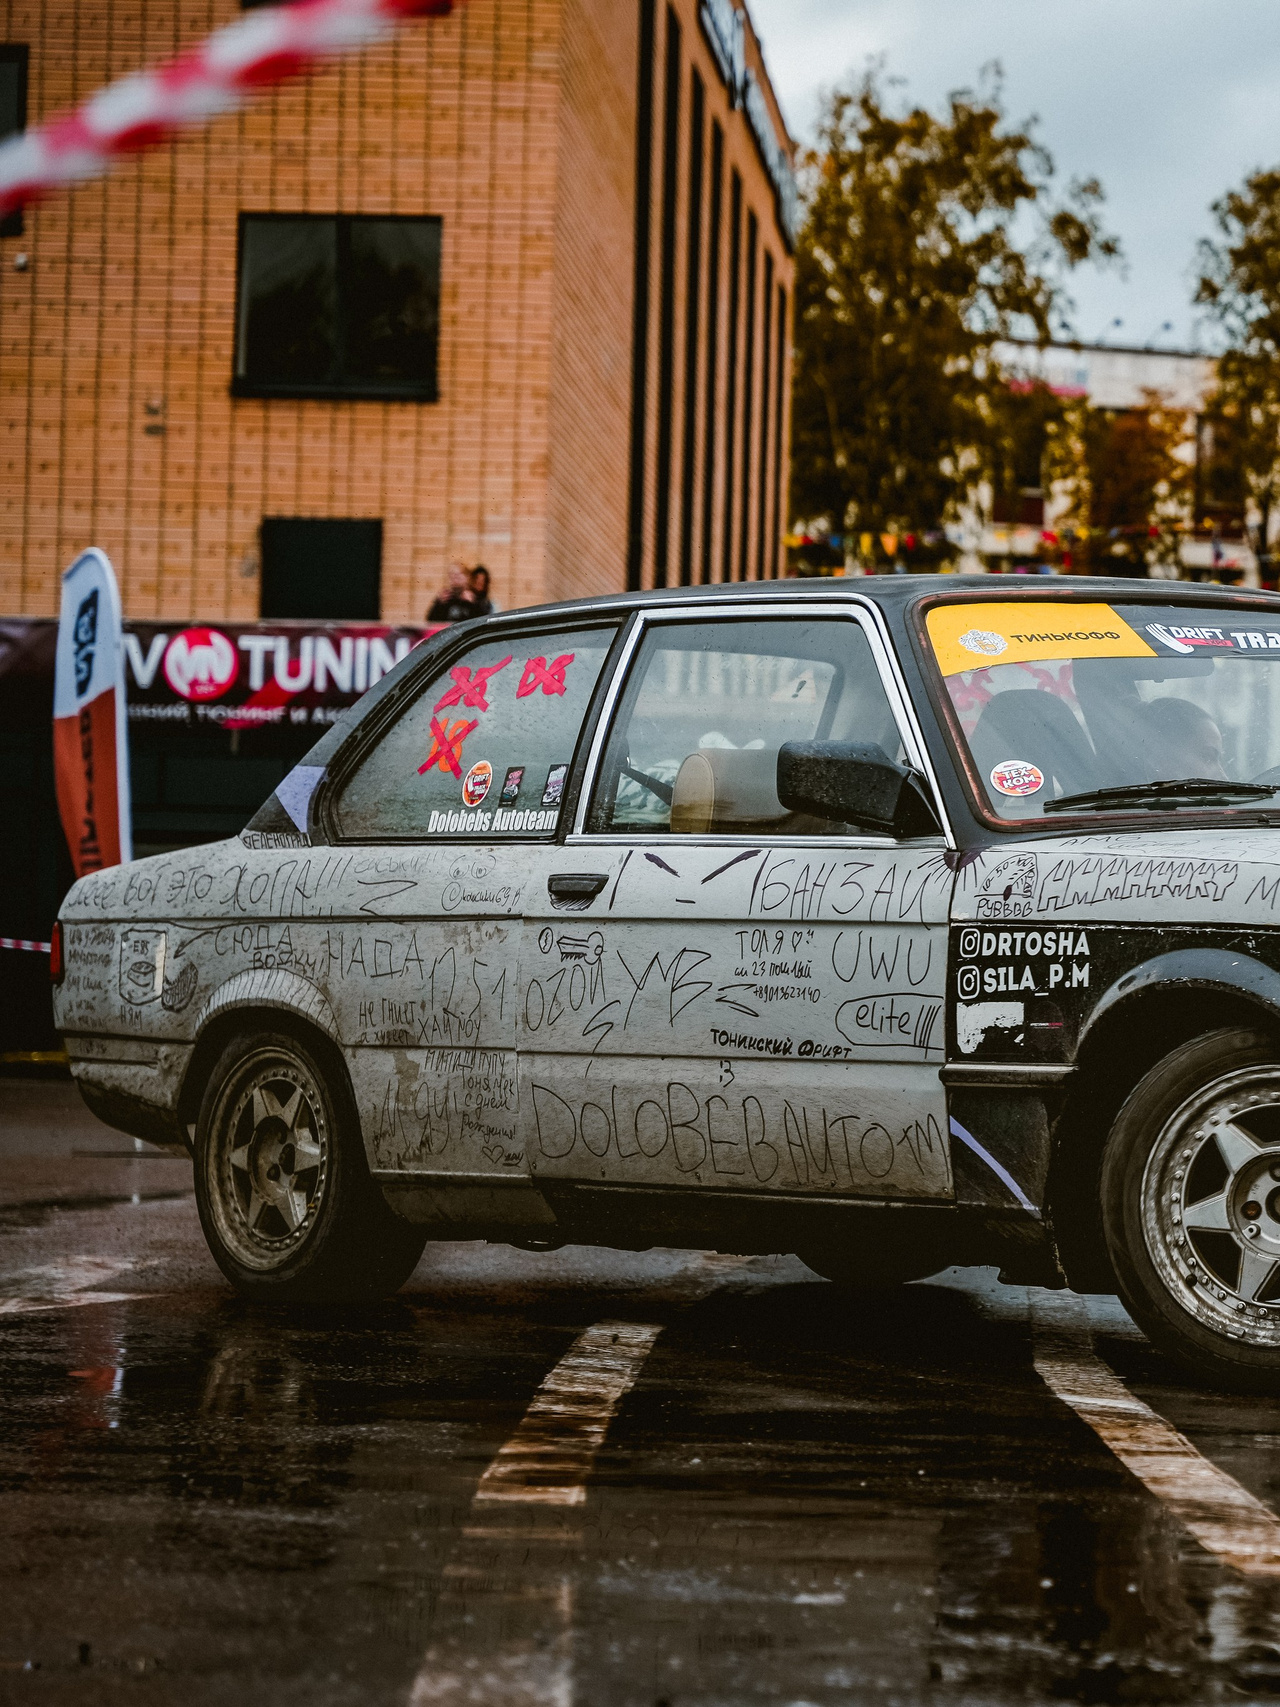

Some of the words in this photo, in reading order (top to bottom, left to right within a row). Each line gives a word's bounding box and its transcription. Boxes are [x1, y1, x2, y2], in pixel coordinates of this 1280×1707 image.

[1009, 630, 1121, 644] ТИНЬКОФФ
[1168, 626, 1224, 641] DRIFT
[237, 634, 414, 692] TUNIN
[1002, 774, 1036, 789] КОМ
[1003, 766, 1030, 779] ТЕХ
[490, 808, 559, 832] Autoteam
[214, 924, 295, 957] СЮДА
[981, 931, 1091, 957] DRTOSHA
[751, 960, 766, 977] 23
[831, 930, 932, 986] UWU
[982, 961, 1091, 996] SILA_P.M
